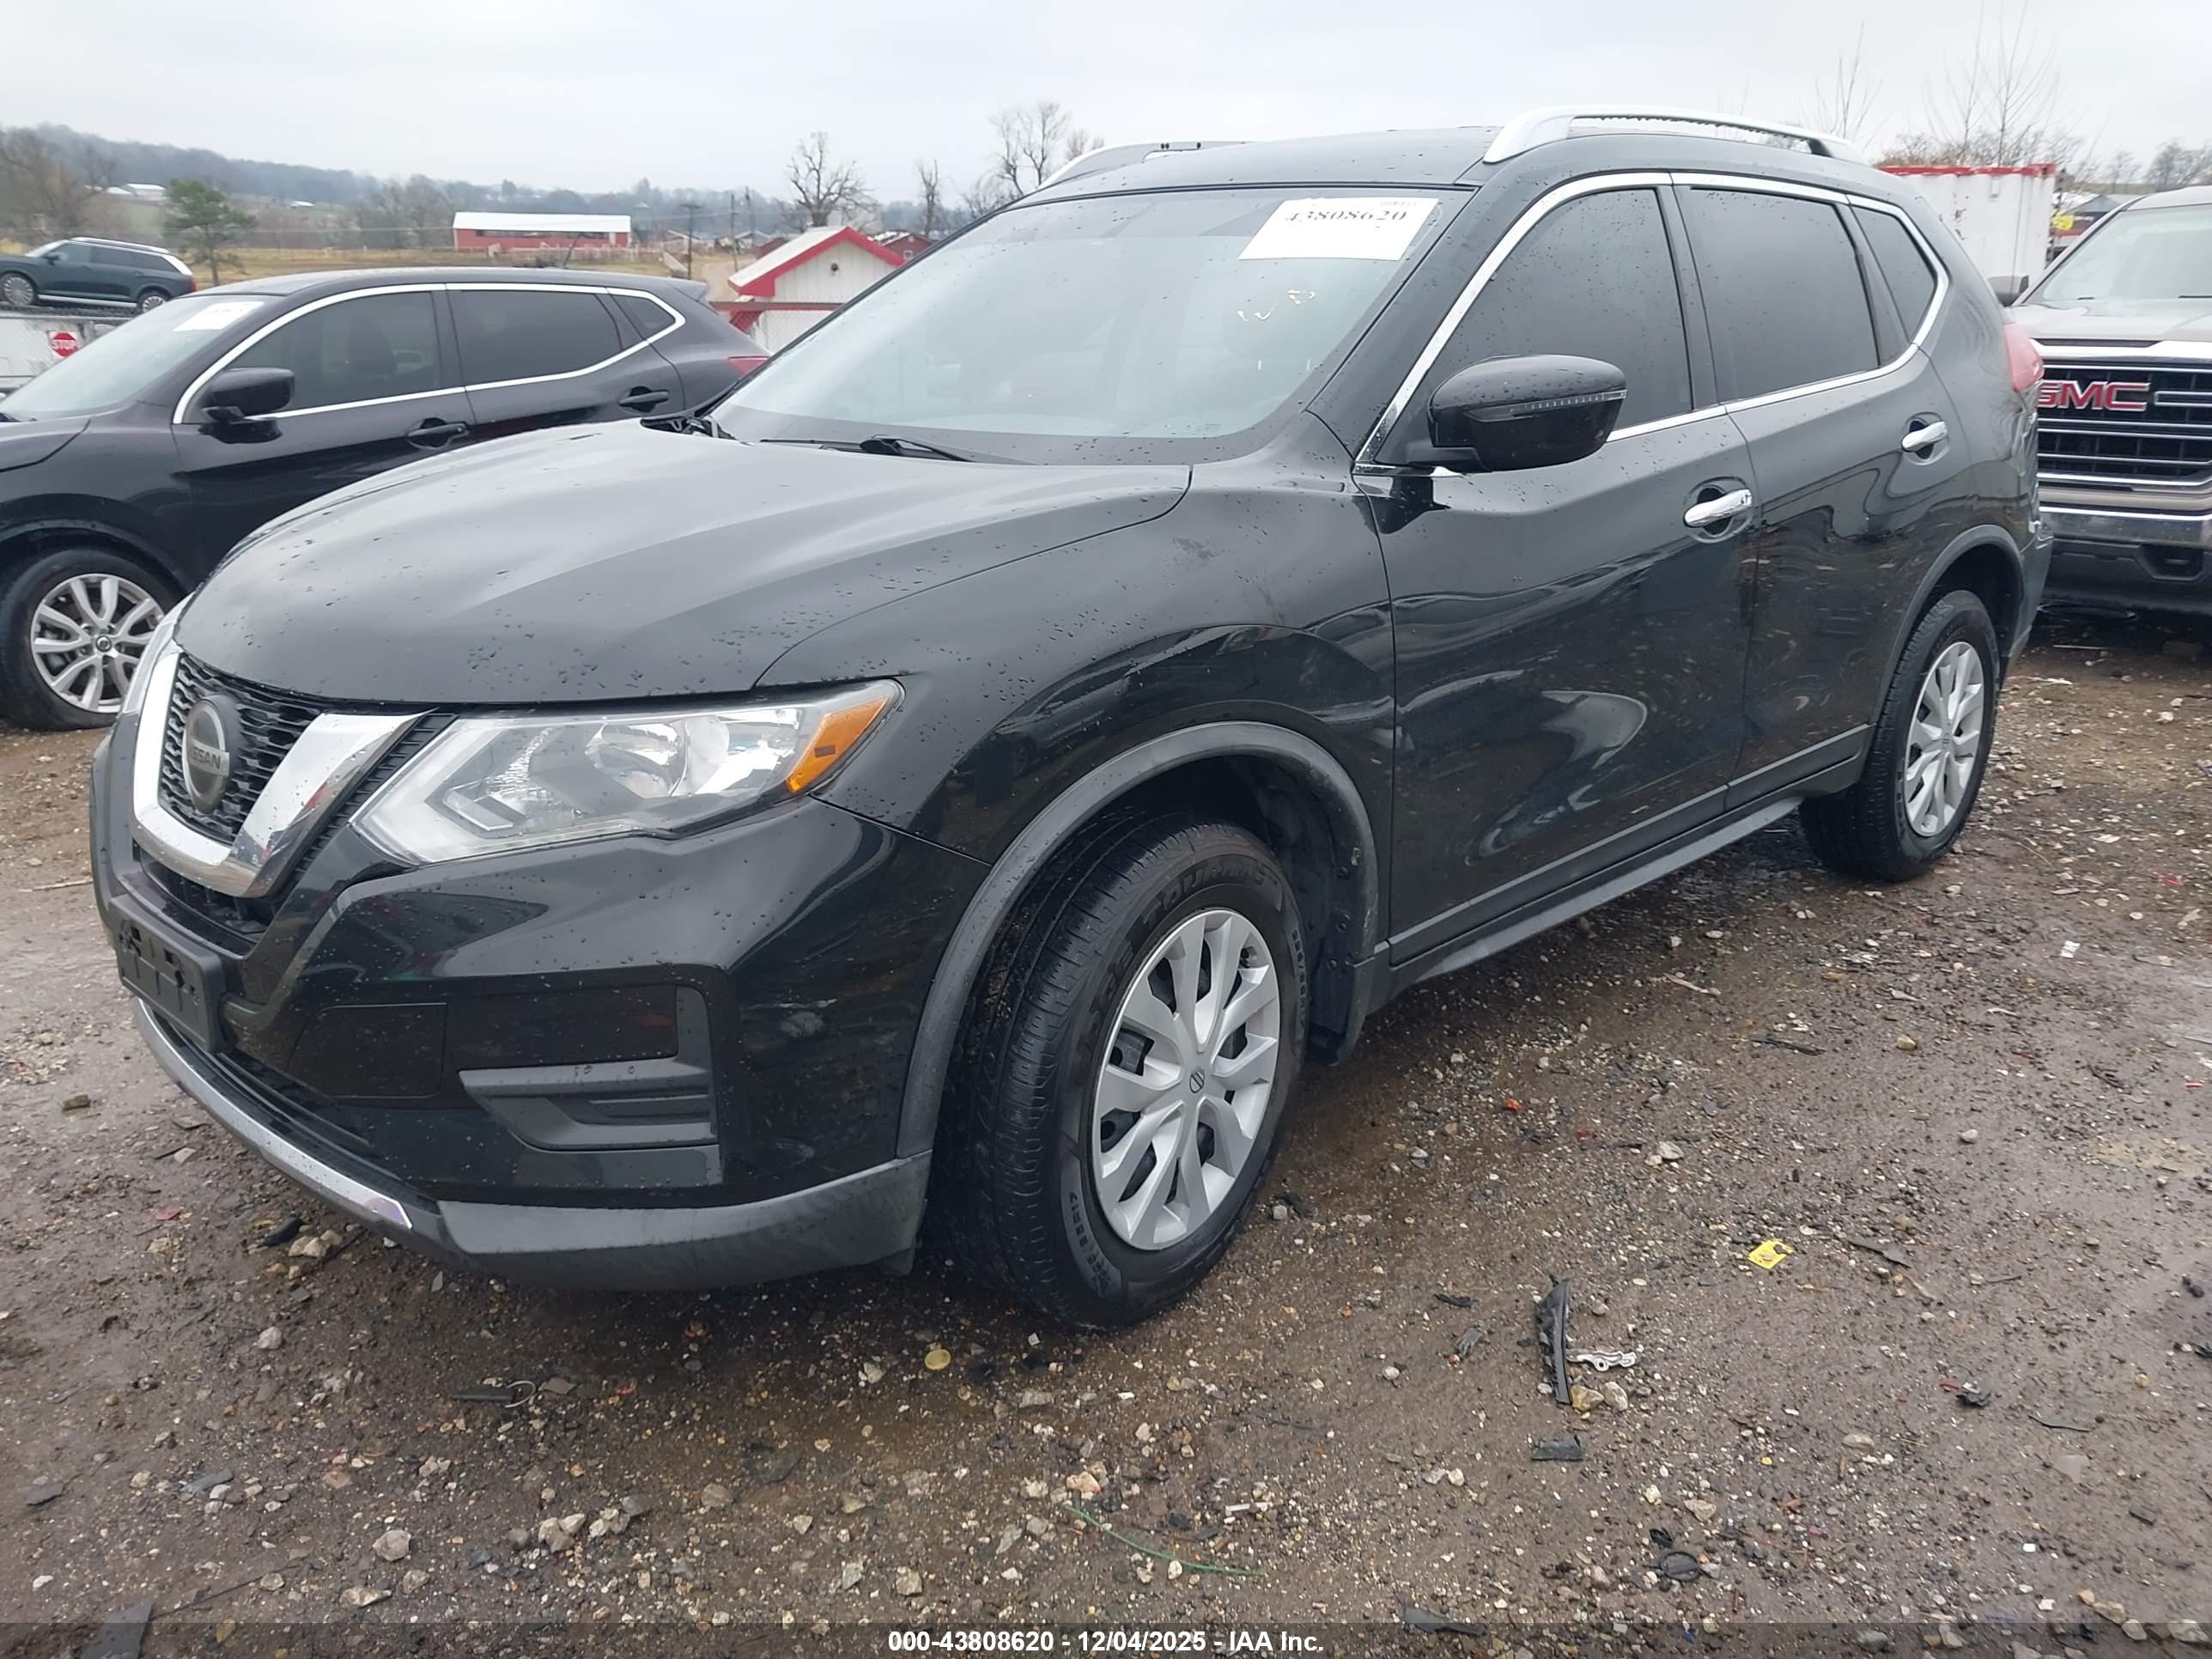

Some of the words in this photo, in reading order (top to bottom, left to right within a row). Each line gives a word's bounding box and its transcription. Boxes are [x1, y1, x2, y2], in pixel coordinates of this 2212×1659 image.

[1285, 210, 1407, 222] 43808620
[52, 338, 77, 350] STOP
[189, 744, 222, 770] SSAN
